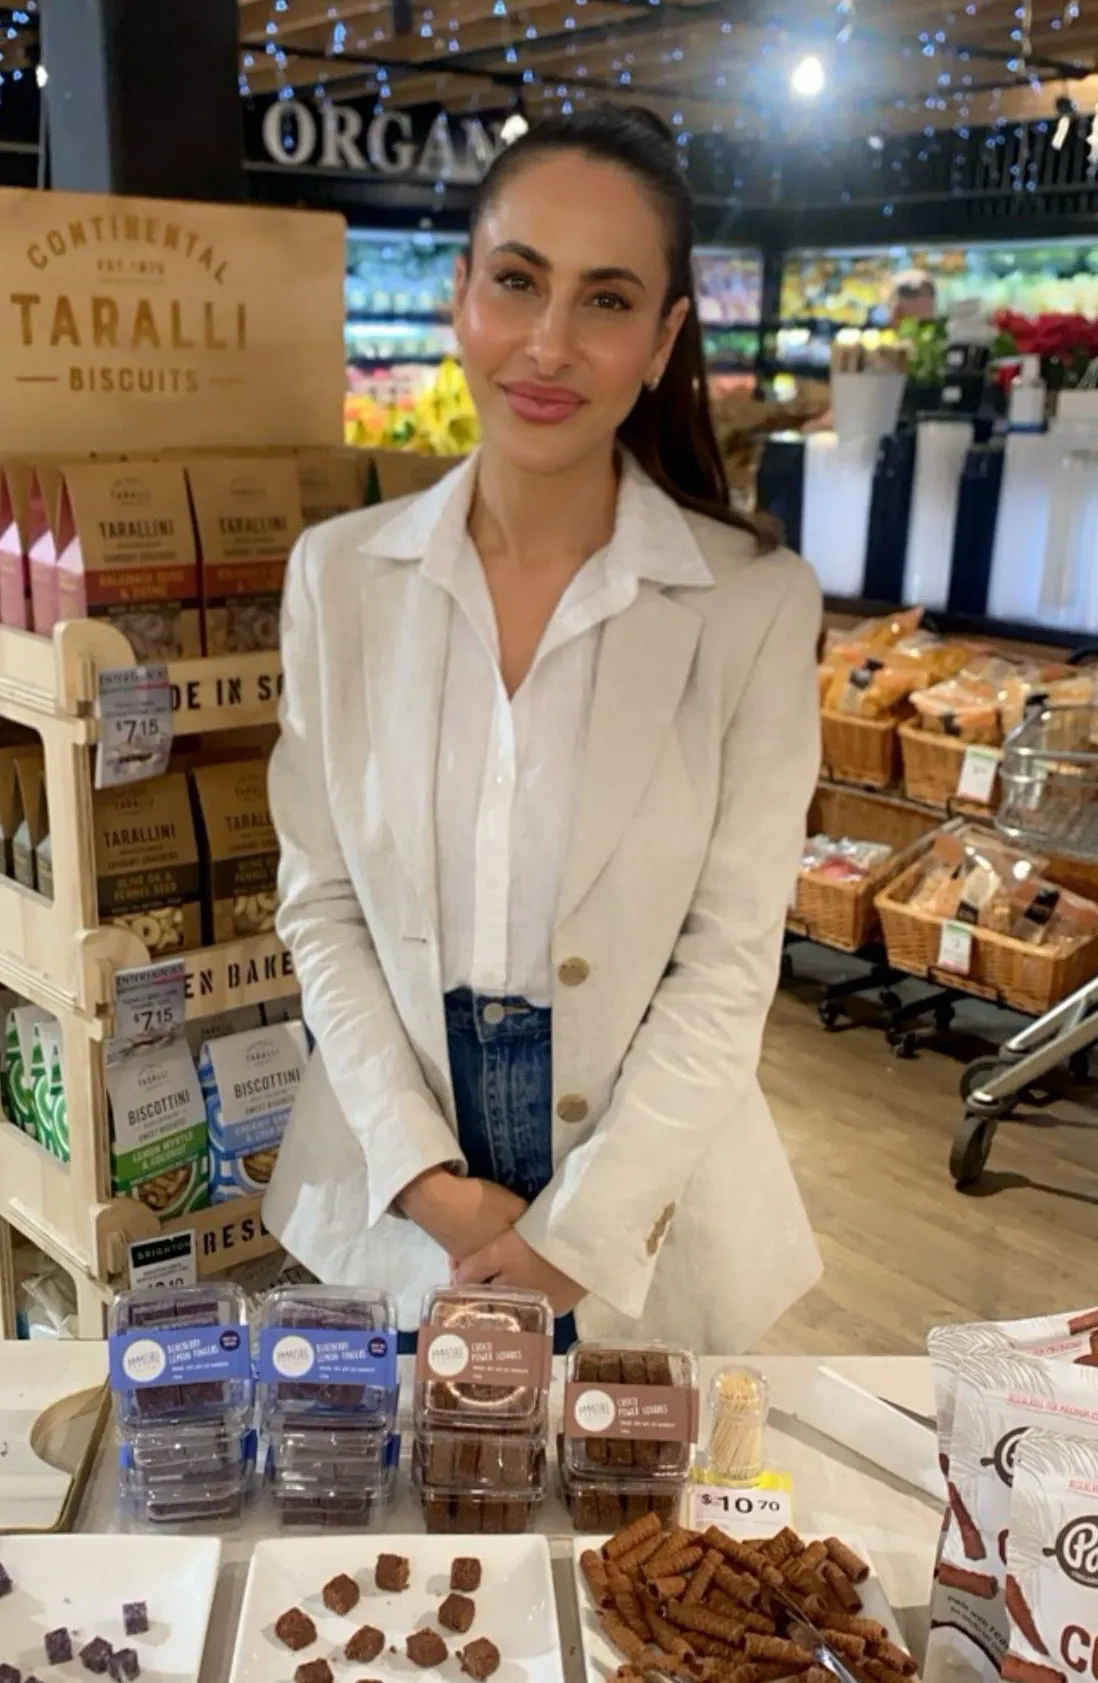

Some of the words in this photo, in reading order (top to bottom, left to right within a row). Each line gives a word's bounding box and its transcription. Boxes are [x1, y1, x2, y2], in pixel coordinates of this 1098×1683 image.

[27, 214, 228, 286] CONTINENTAL
[10, 292, 247, 351] TARALLI
[69, 367, 200, 393] BISCUITS
[98, 517, 174, 539] TARALLINI
[218, 515, 287, 534] TARALLINI
[216, 676, 242, 707] IN
[103, 823, 176, 849] TARALLINI
[233, 1067, 300, 1099] BISCOTTINI
[128, 1088, 191, 1127] BISCOTTINI
[136, 1241, 190, 1262] BRIGHTON
